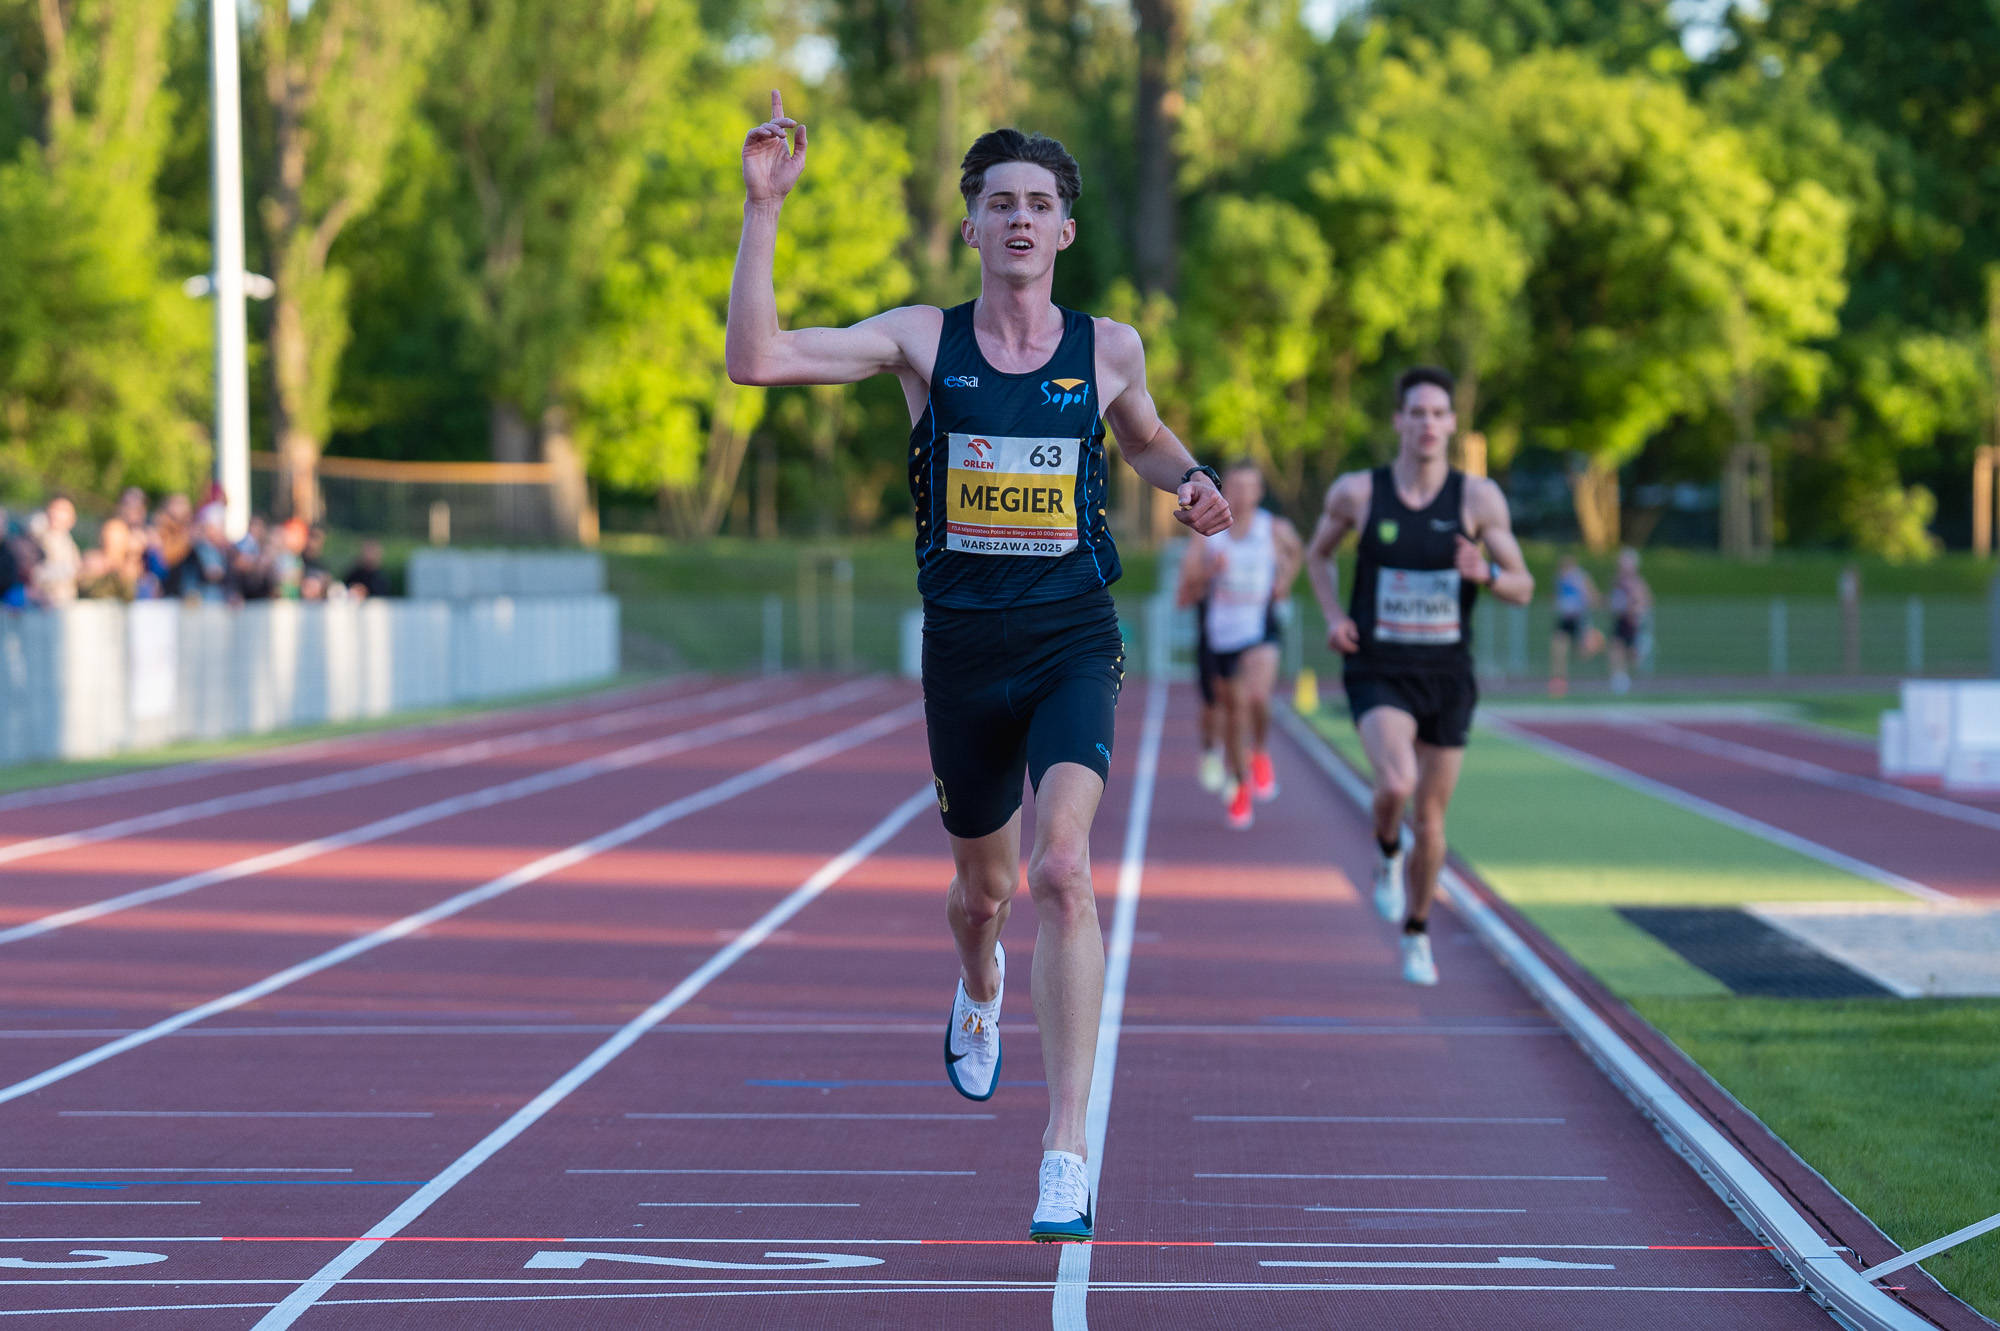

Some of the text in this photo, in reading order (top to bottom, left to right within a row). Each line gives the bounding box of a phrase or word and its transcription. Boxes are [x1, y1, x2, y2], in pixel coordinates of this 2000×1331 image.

[1040, 380, 1090, 412] Sopot
[963, 459, 995, 470] ORLEN
[1029, 445, 1062, 468] 63
[960, 483, 1064, 514] MEGIER
[960, 538, 1063, 553] WARSZAWA 2025
[523, 1251, 886, 1270] 2
[1257, 1256, 1616, 1270] 1
